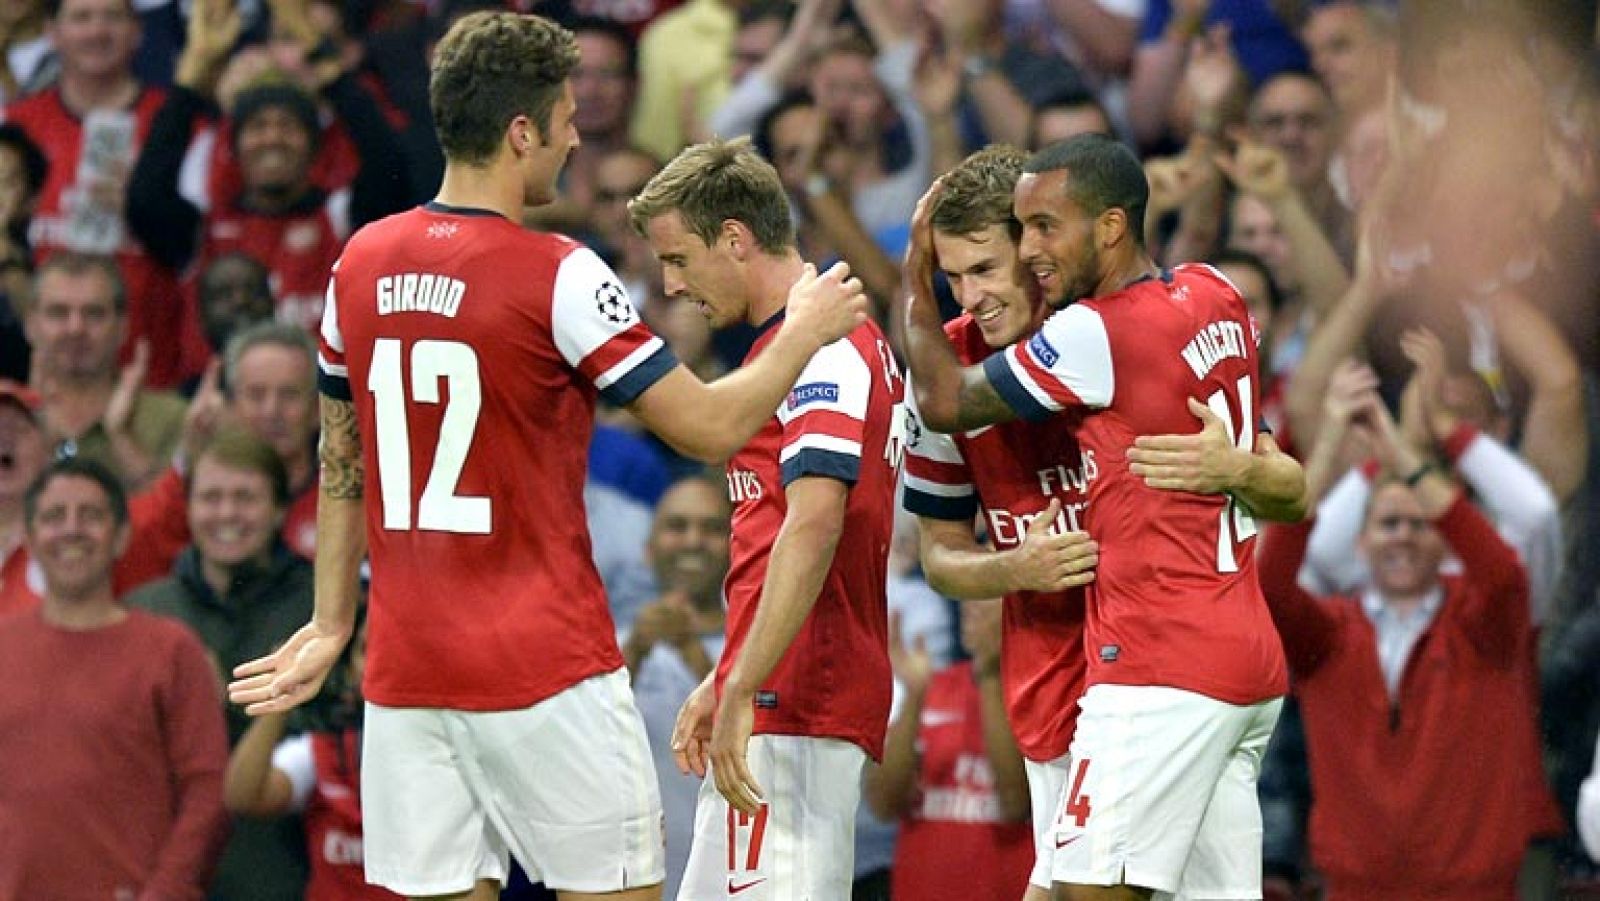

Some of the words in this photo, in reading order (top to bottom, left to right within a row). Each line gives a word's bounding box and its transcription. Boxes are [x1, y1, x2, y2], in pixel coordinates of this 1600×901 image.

[377, 272, 466, 318] GIROUD
[368, 338, 493, 534] 12
[727, 801, 768, 871] 17
